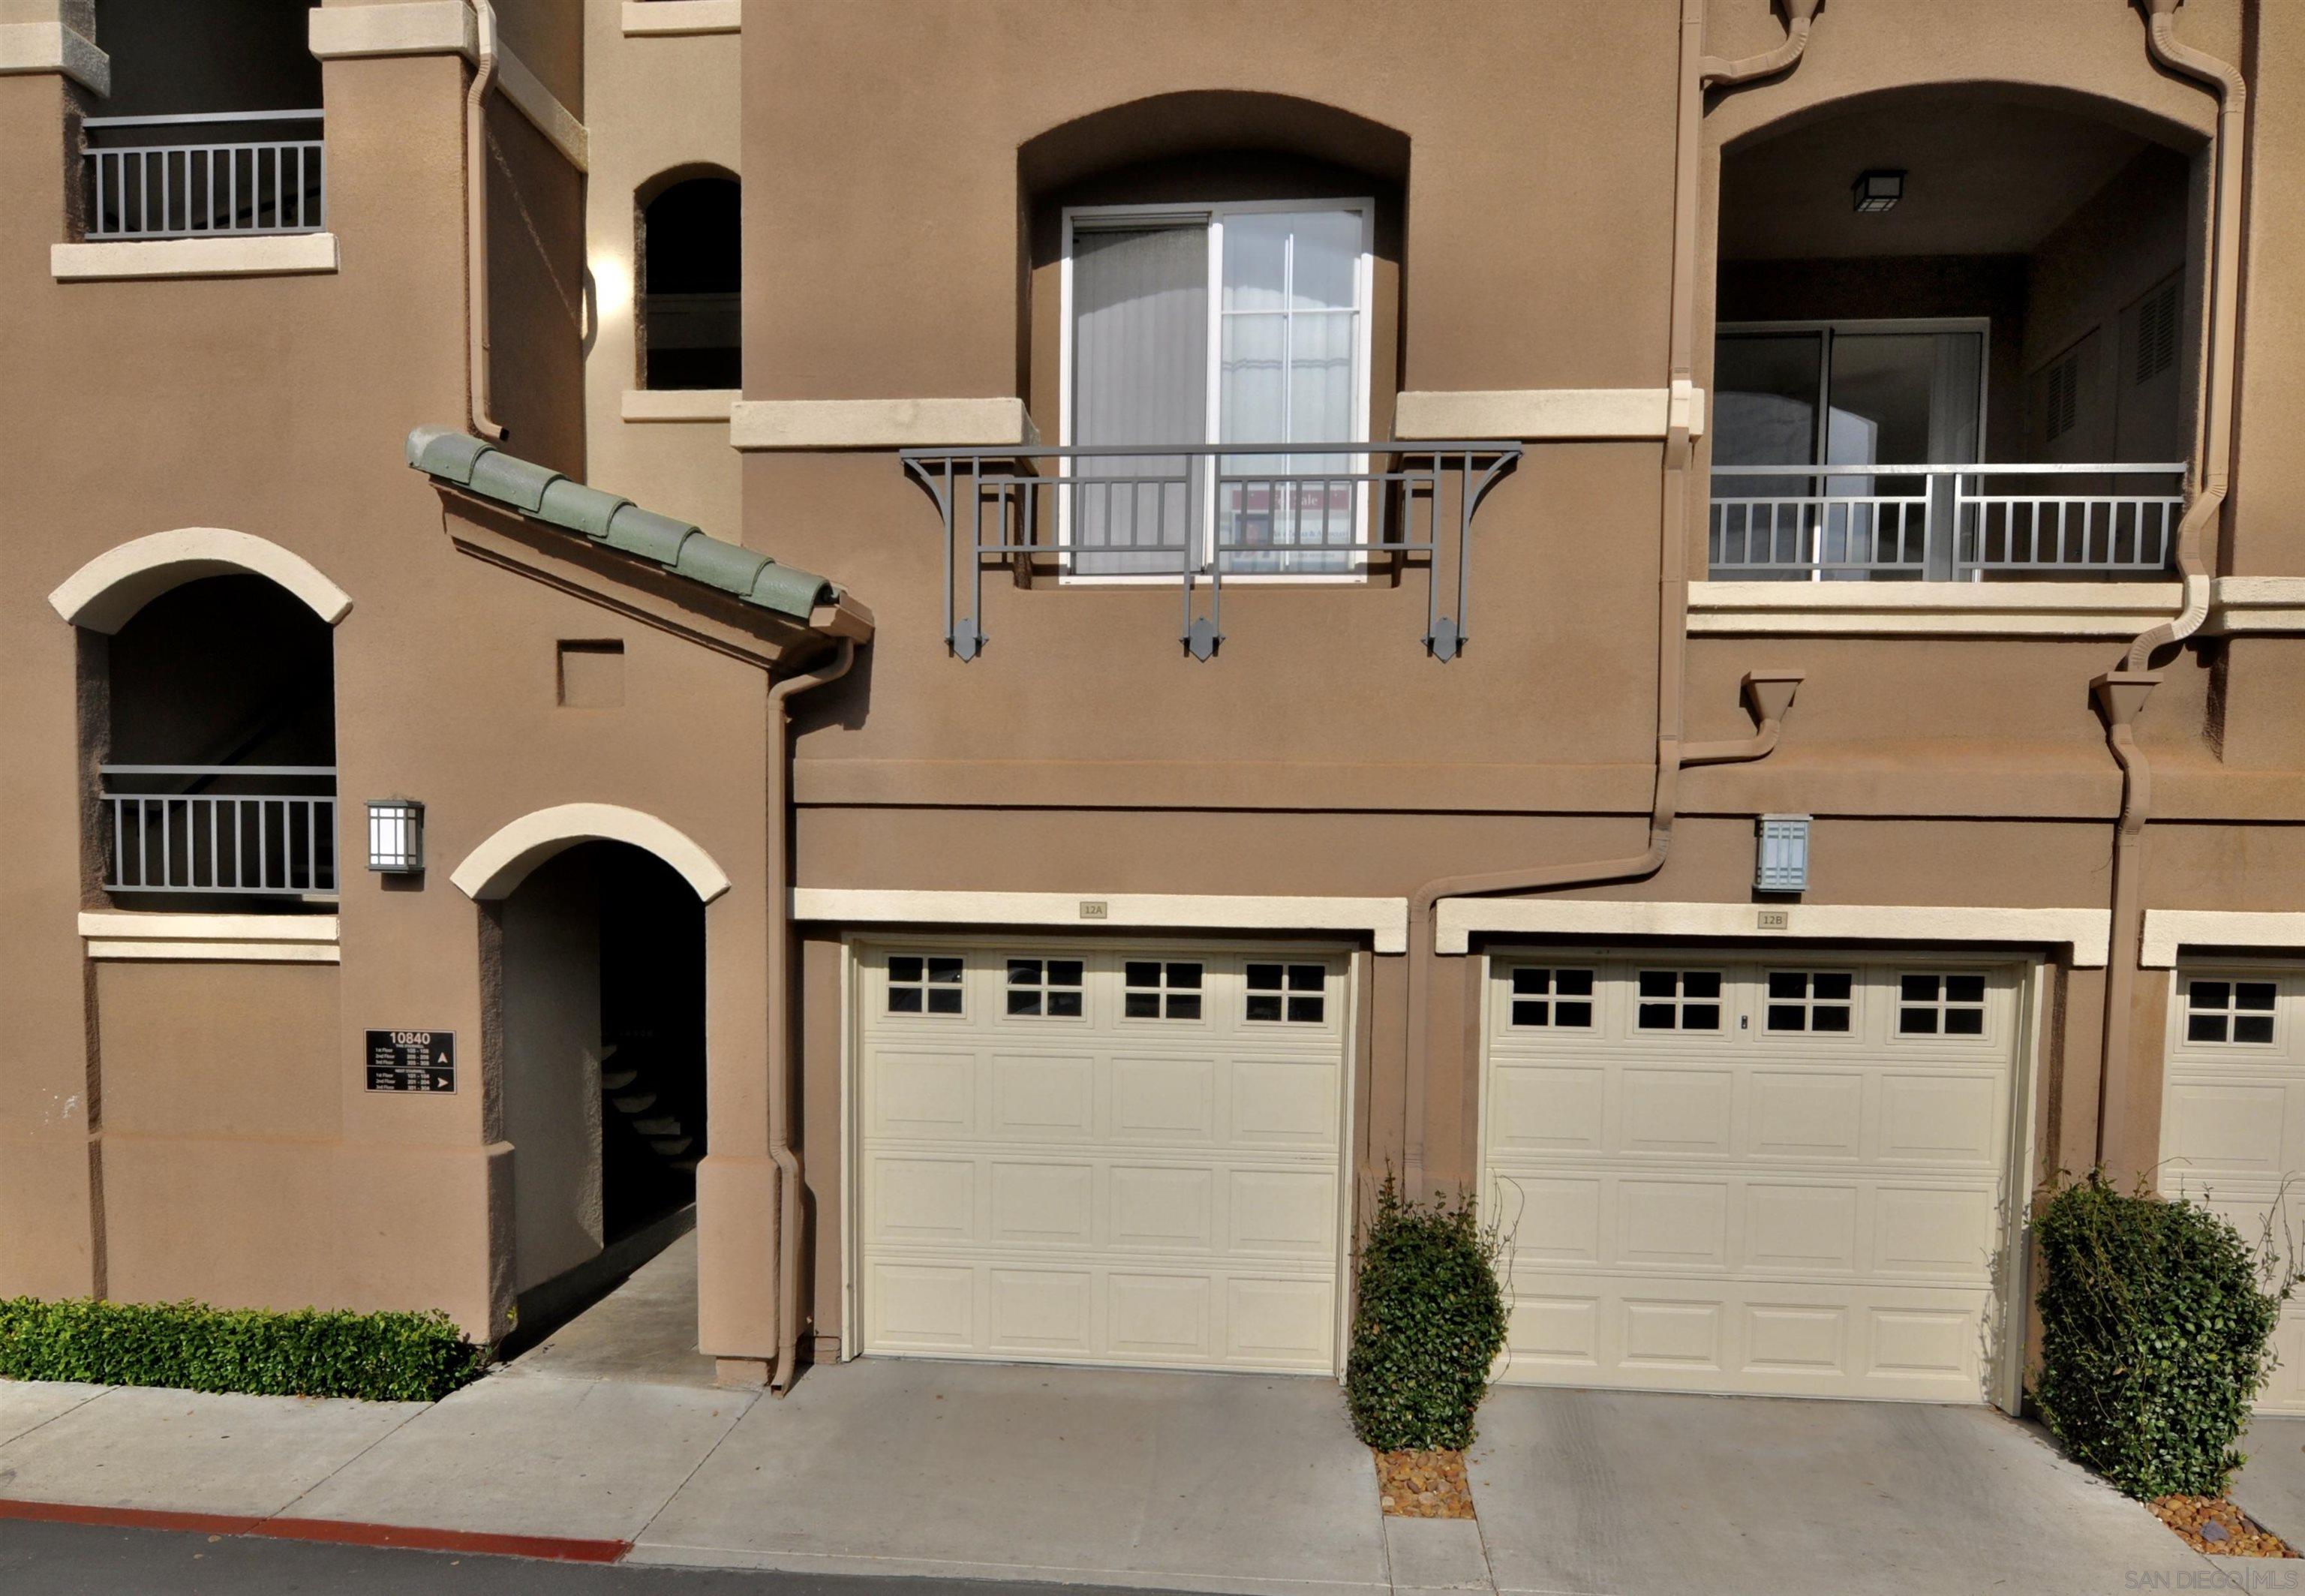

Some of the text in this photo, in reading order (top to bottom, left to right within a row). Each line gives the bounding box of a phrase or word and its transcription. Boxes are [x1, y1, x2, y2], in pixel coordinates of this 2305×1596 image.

[1294, 494, 1318, 506] ale
[1086, 905, 1103, 914] 12A
[1763, 915, 1783, 924] 12B
[389, 1032, 431, 1045] 10840
